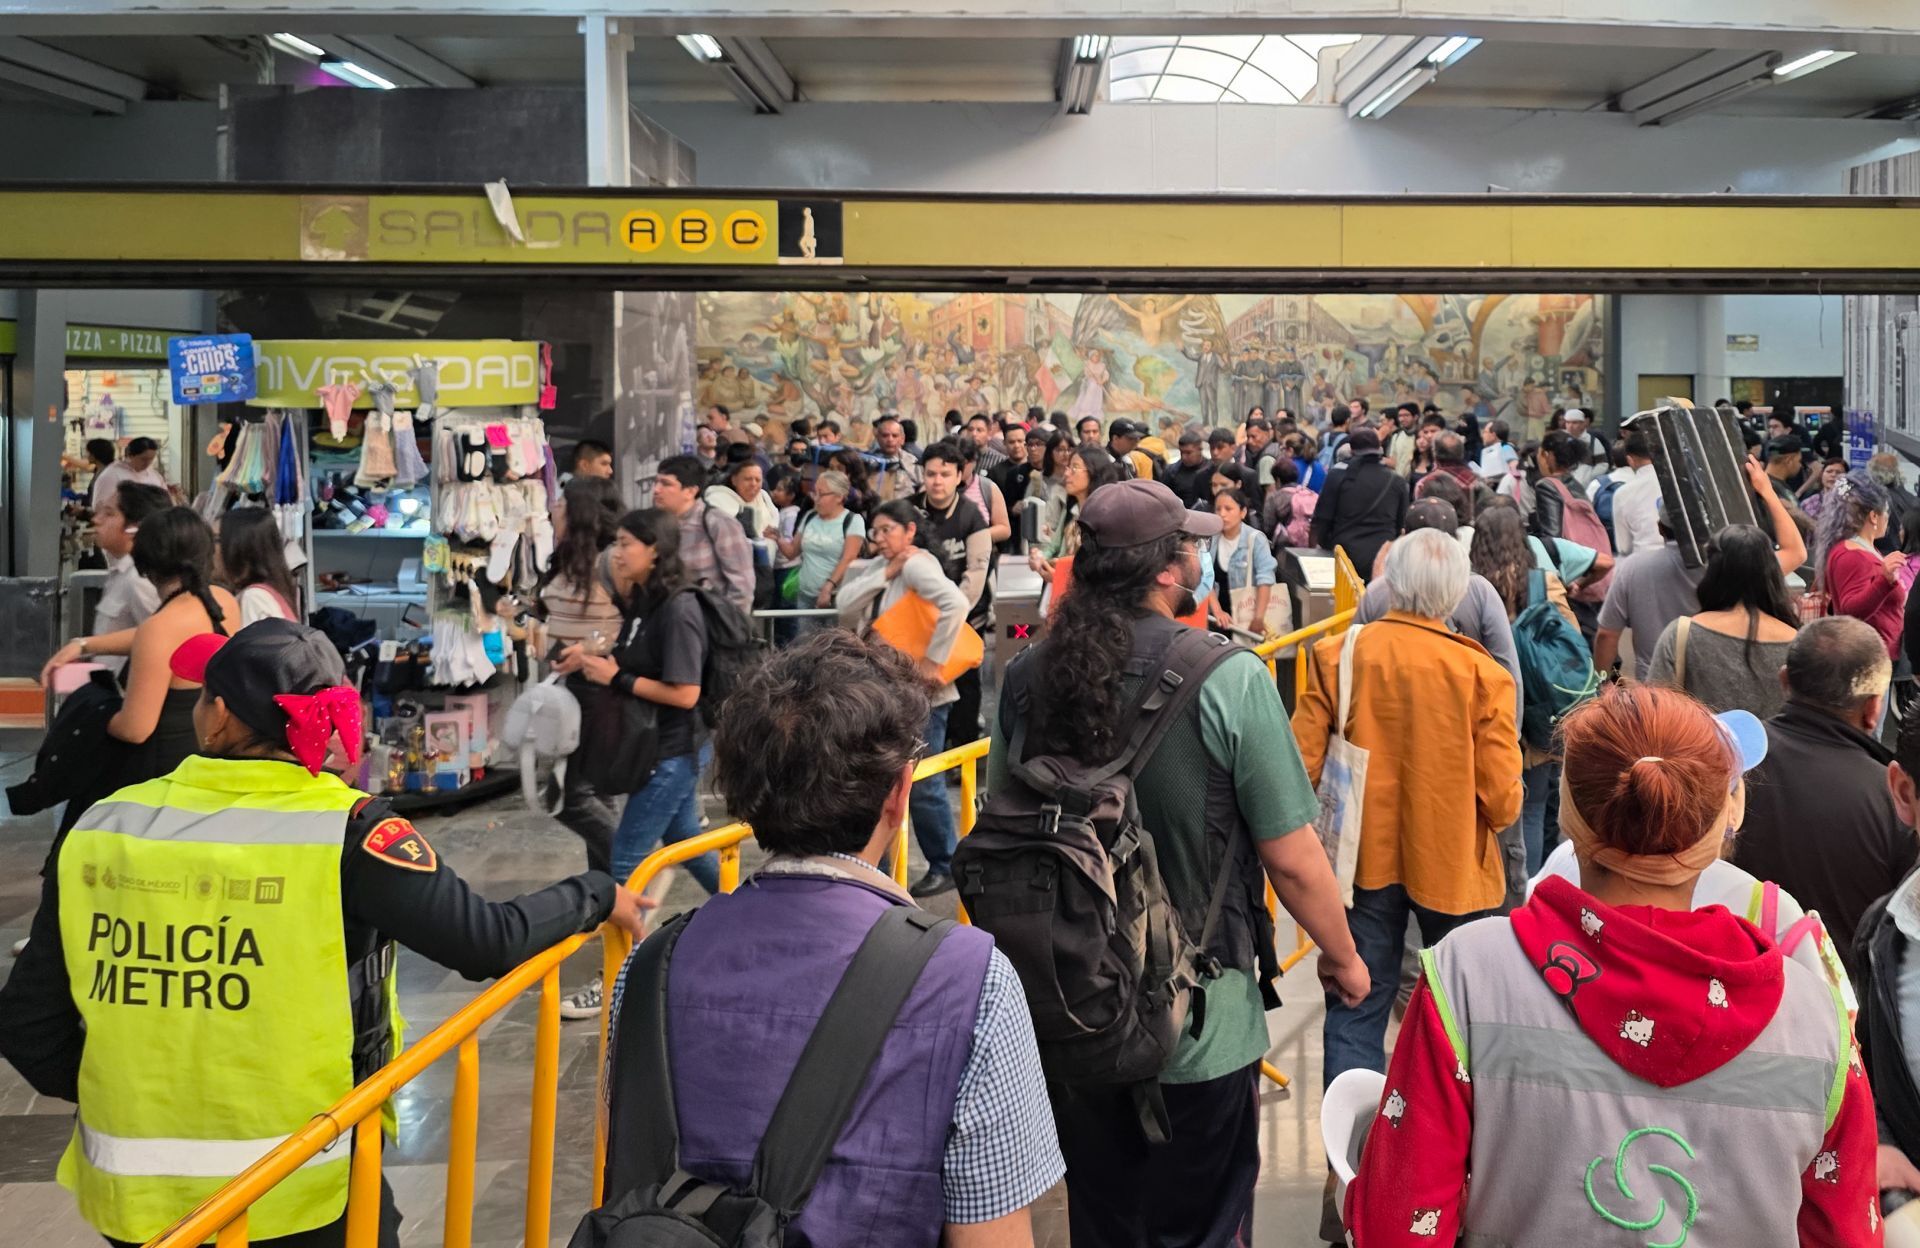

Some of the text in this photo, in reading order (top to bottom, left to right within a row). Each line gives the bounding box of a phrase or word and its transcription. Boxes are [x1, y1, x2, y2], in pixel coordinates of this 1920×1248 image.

[378, 209, 760, 249] SALDA A B C
[120, 331, 162, 354] PIZZA
[187, 347, 238, 375] CHIPS
[88, 912, 264, 967] POLICÍA
[88, 959, 250, 1011] METRO
